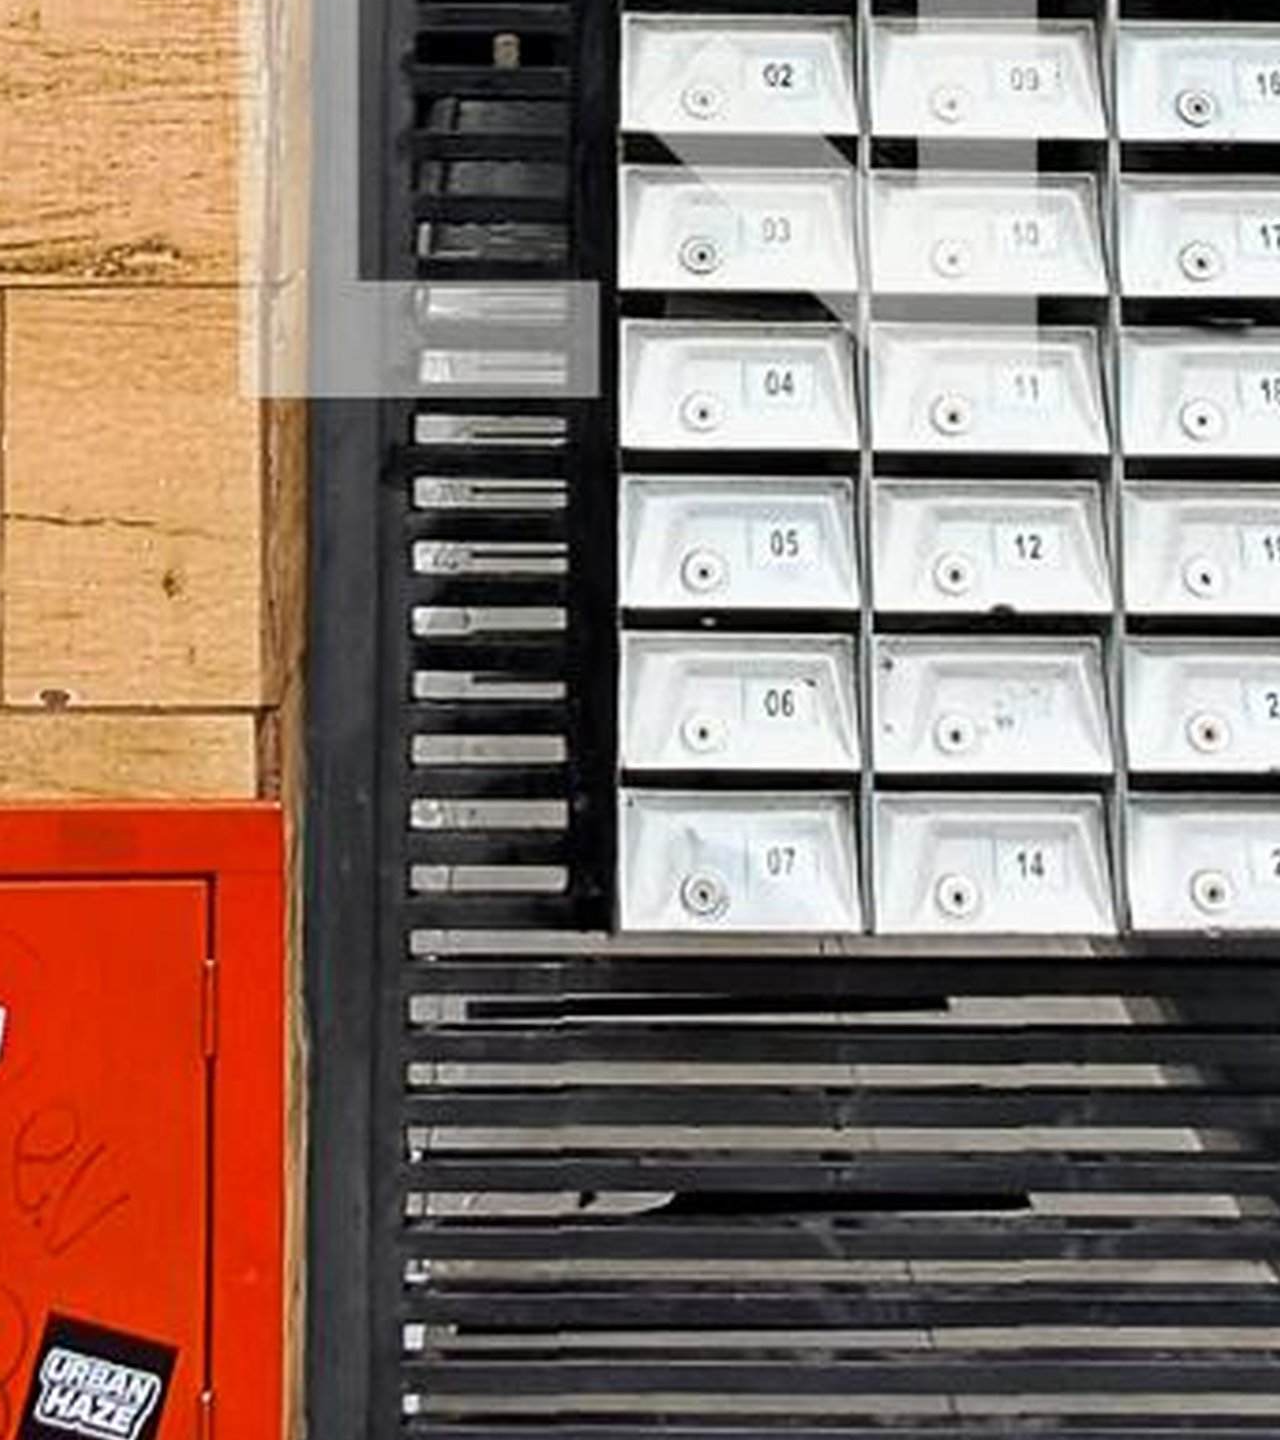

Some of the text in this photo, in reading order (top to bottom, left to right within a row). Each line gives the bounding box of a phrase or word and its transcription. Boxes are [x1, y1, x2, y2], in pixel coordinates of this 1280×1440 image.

[762, 62, 794, 89] 02
[764, 369, 795, 397] 04
[769, 528, 800, 557] 05
[1014, 533, 1042, 560] 12
[763, 688, 795, 718] 06
[766, 846, 796, 877] 07
[1016, 850, 1045, 878] 14
[46, 1353, 153, 1406] URBAN
[43, 1385, 138, 1433] HAZE
